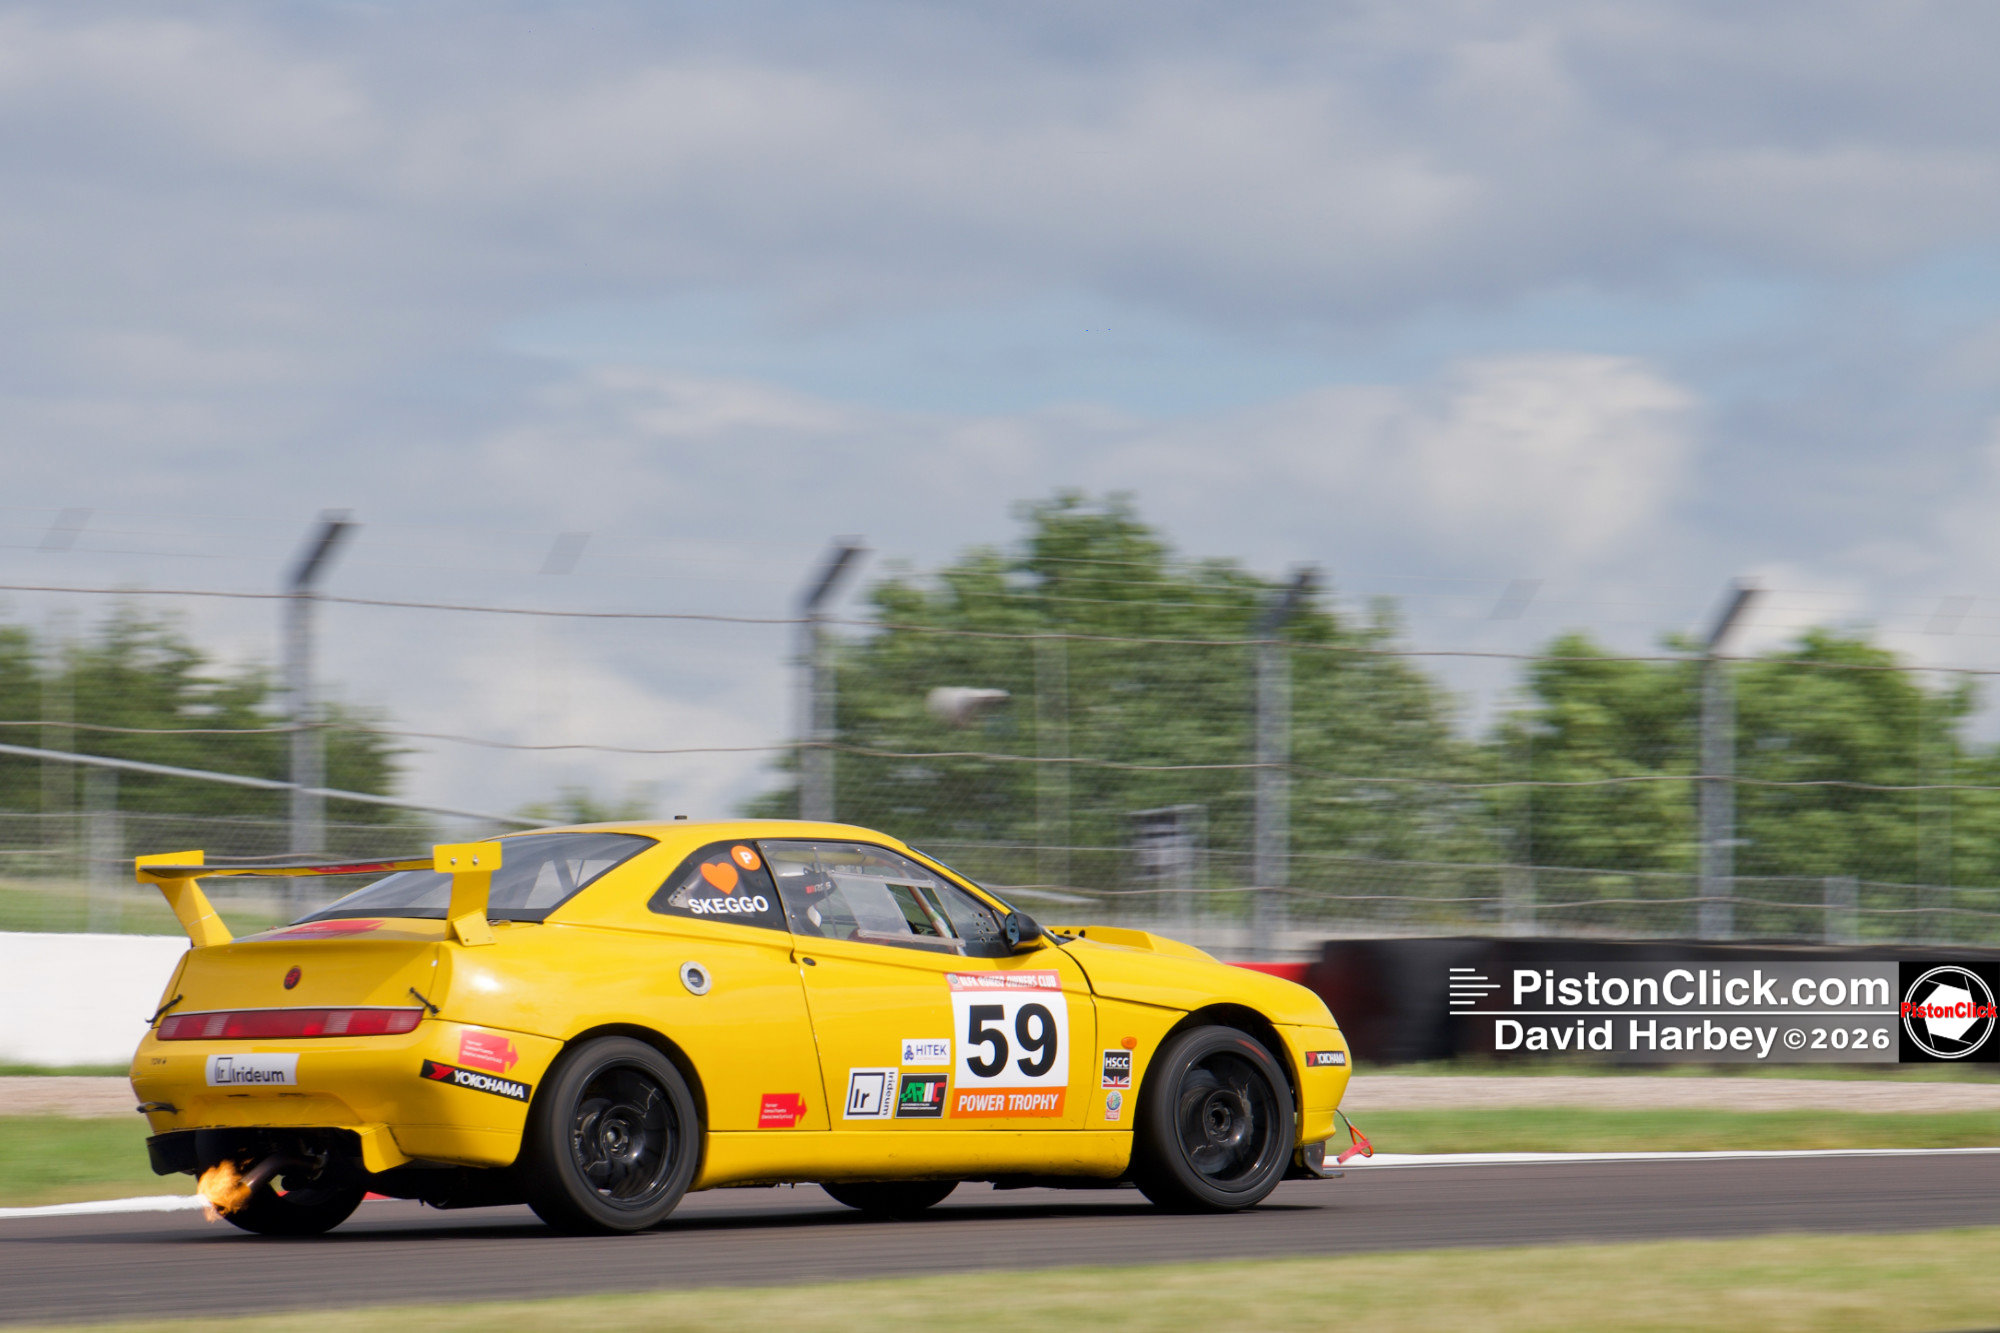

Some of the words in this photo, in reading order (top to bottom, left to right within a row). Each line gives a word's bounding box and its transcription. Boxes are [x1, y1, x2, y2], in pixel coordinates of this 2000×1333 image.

[739, 851, 752, 864] P
[688, 895, 769, 914] SKEGGO
[967, 1003, 1058, 1078] 59
[916, 1044, 947, 1056] HITEK
[1105, 1057, 1129, 1068] HSCC
[232, 1066, 285, 1083] Irideum
[454, 1070, 524, 1098] YOKOHAMA
[853, 1088, 870, 1109] Ir
[957, 1094, 1004, 1112] POWER
[1008, 1094, 1059, 1111] TROPHY
